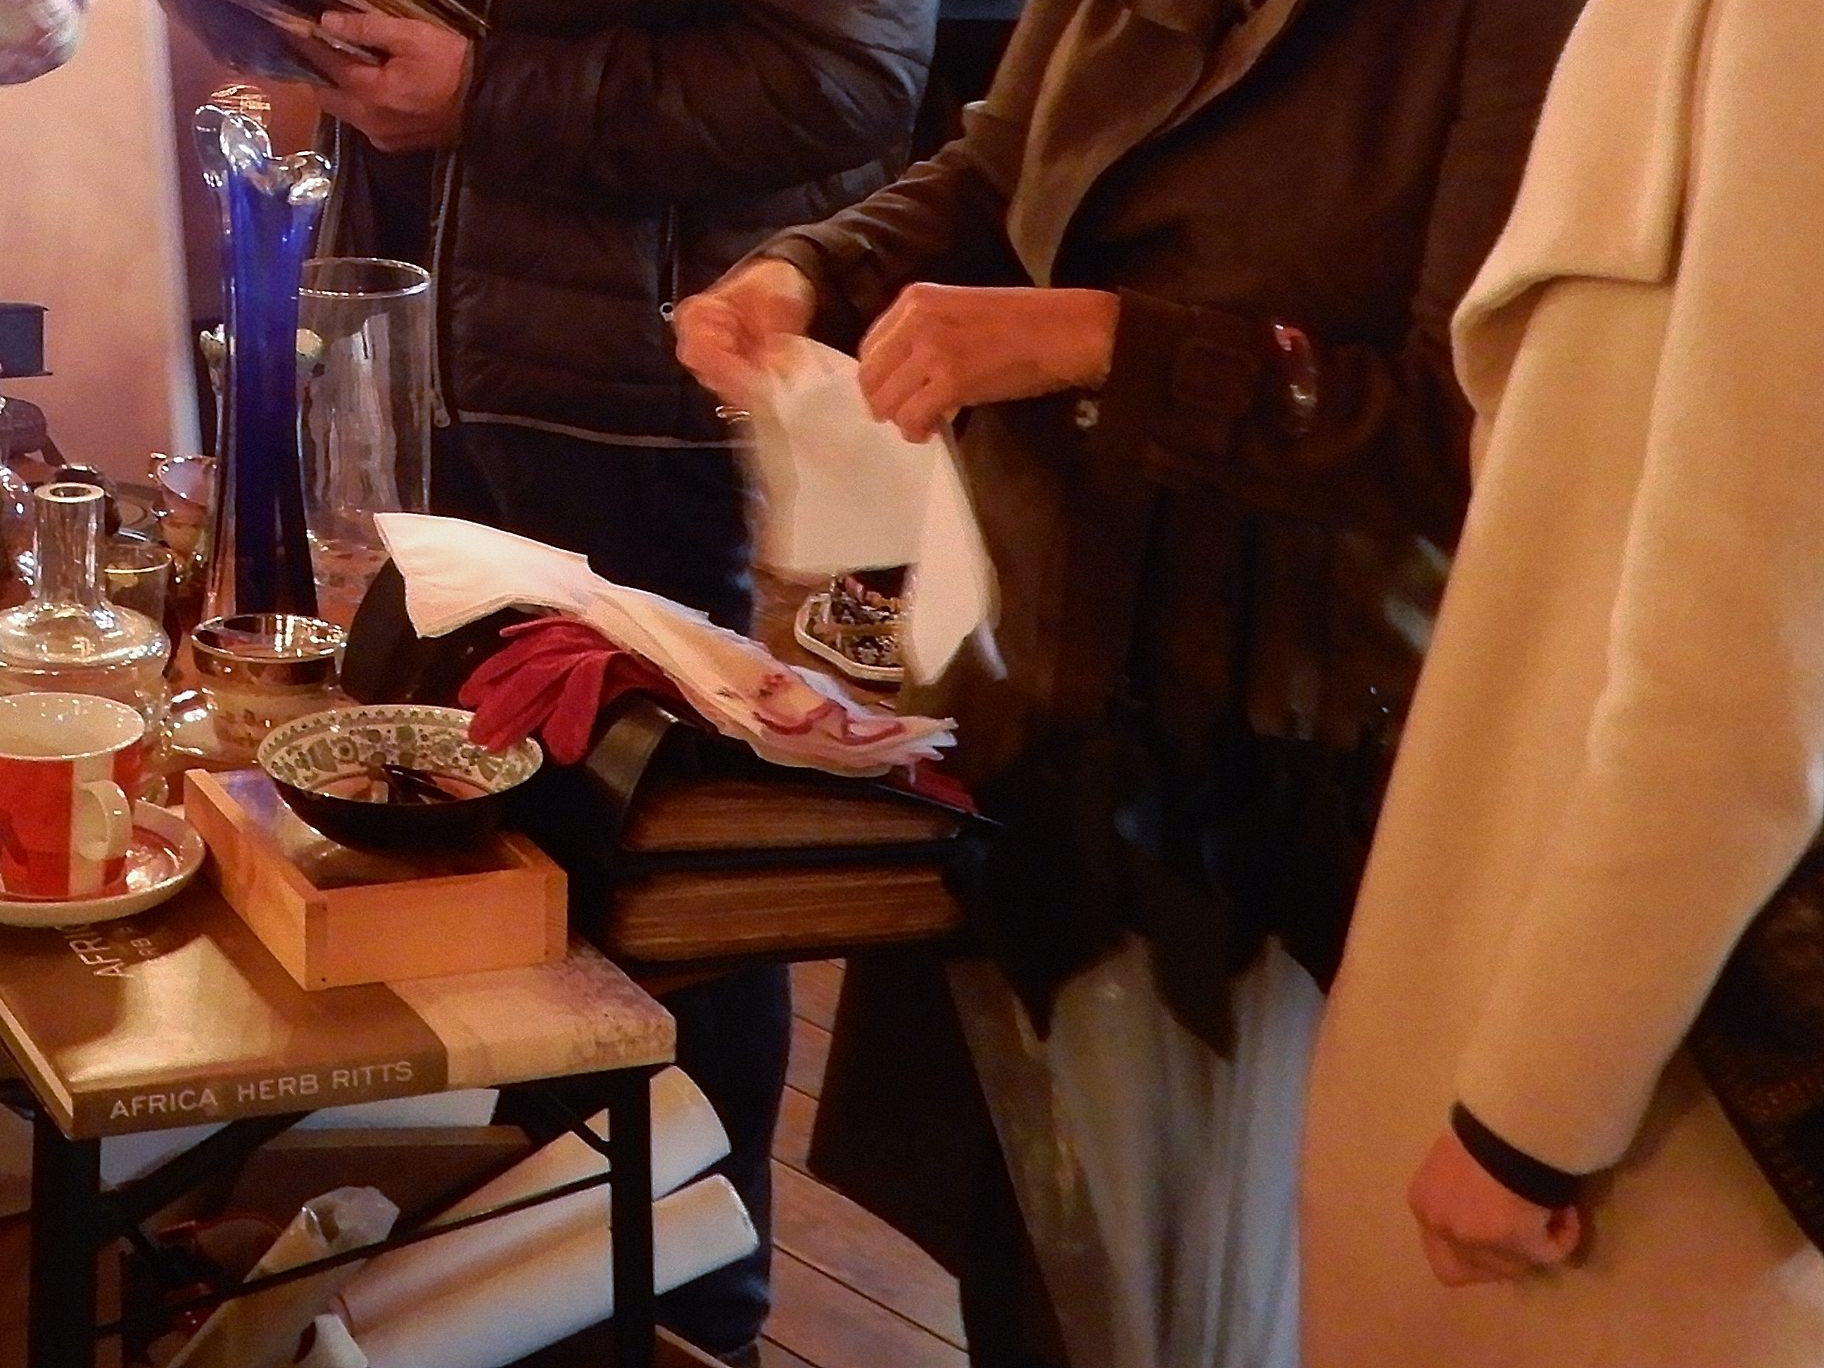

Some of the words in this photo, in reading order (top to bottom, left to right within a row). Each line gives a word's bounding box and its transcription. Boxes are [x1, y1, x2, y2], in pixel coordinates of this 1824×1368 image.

[109, 1087, 218, 1120] AFRICA
[237, 1073, 320, 1103] HERB
[331, 1061, 414, 1090] RITTS
